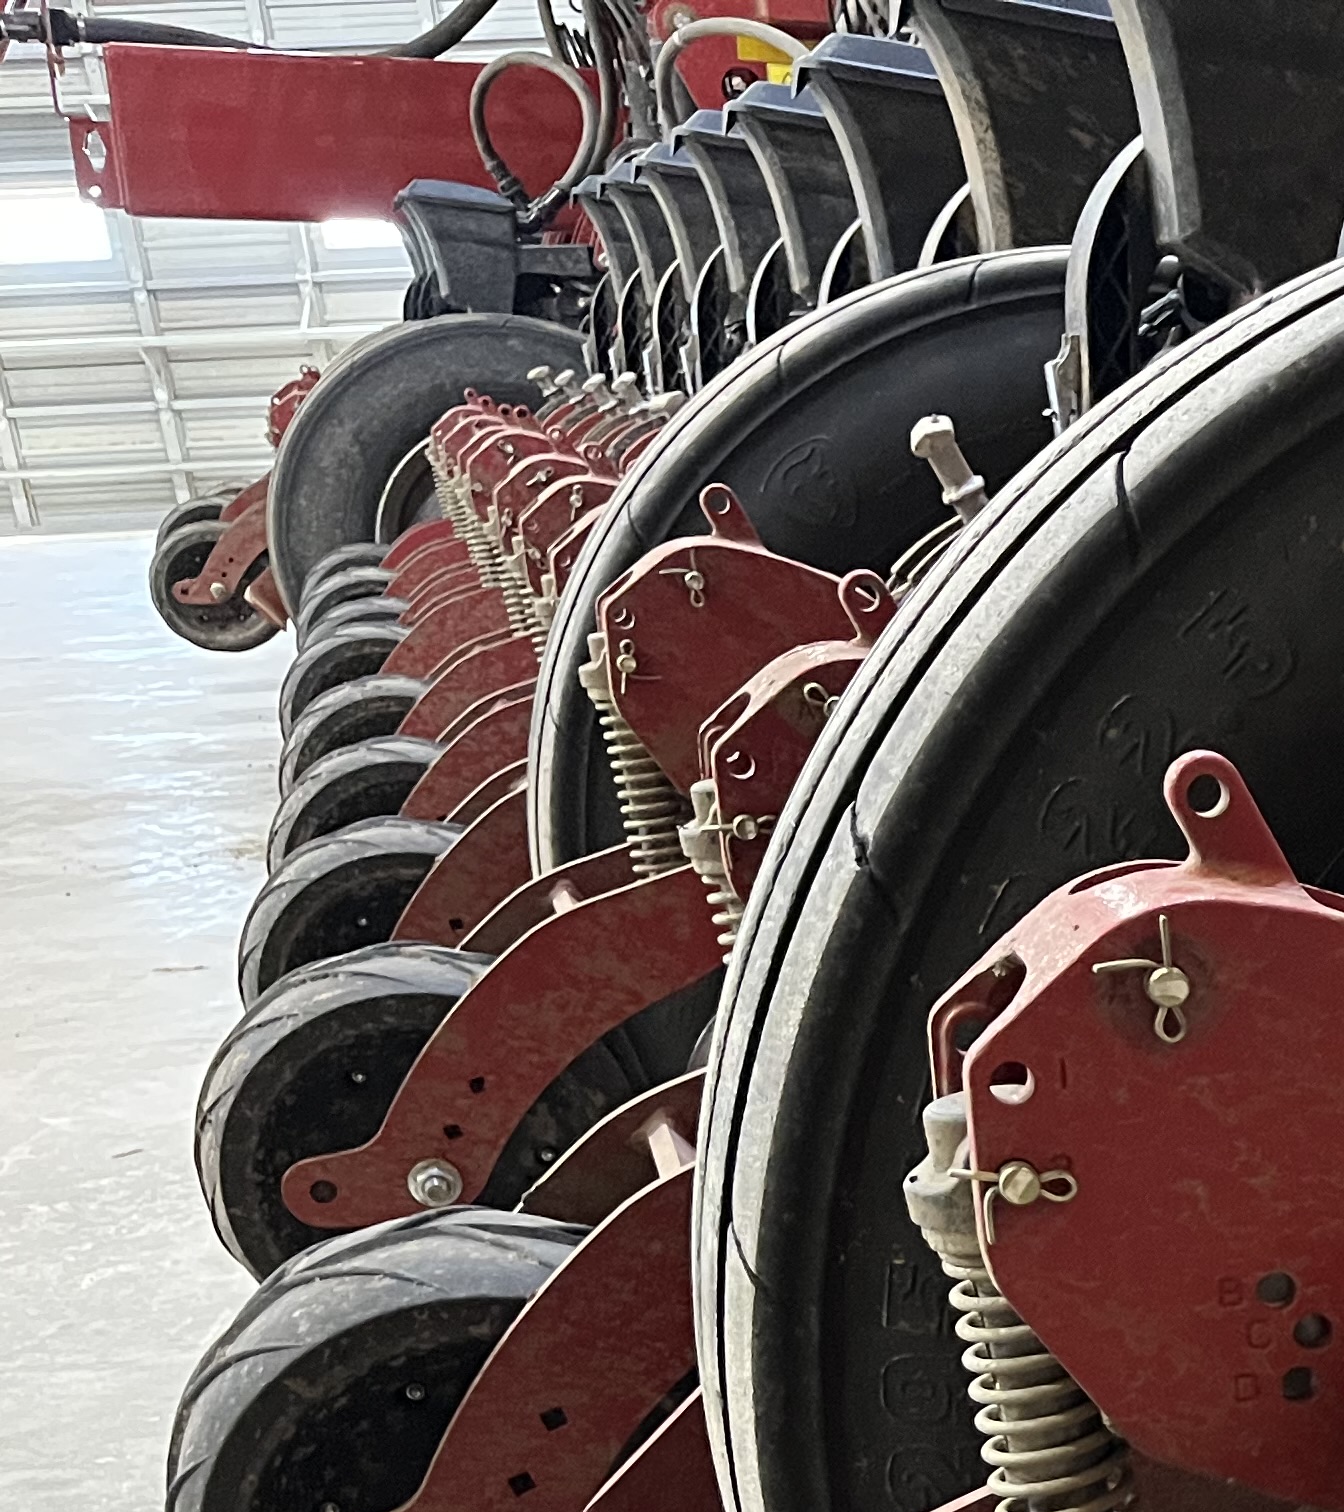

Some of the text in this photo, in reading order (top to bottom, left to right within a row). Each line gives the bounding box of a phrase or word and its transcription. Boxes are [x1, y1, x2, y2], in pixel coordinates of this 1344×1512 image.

[1218, 1276, 1243, 1307] B
[1247, 1321, 1272, 1350] C
[1233, 1372, 1261, 1402] D
